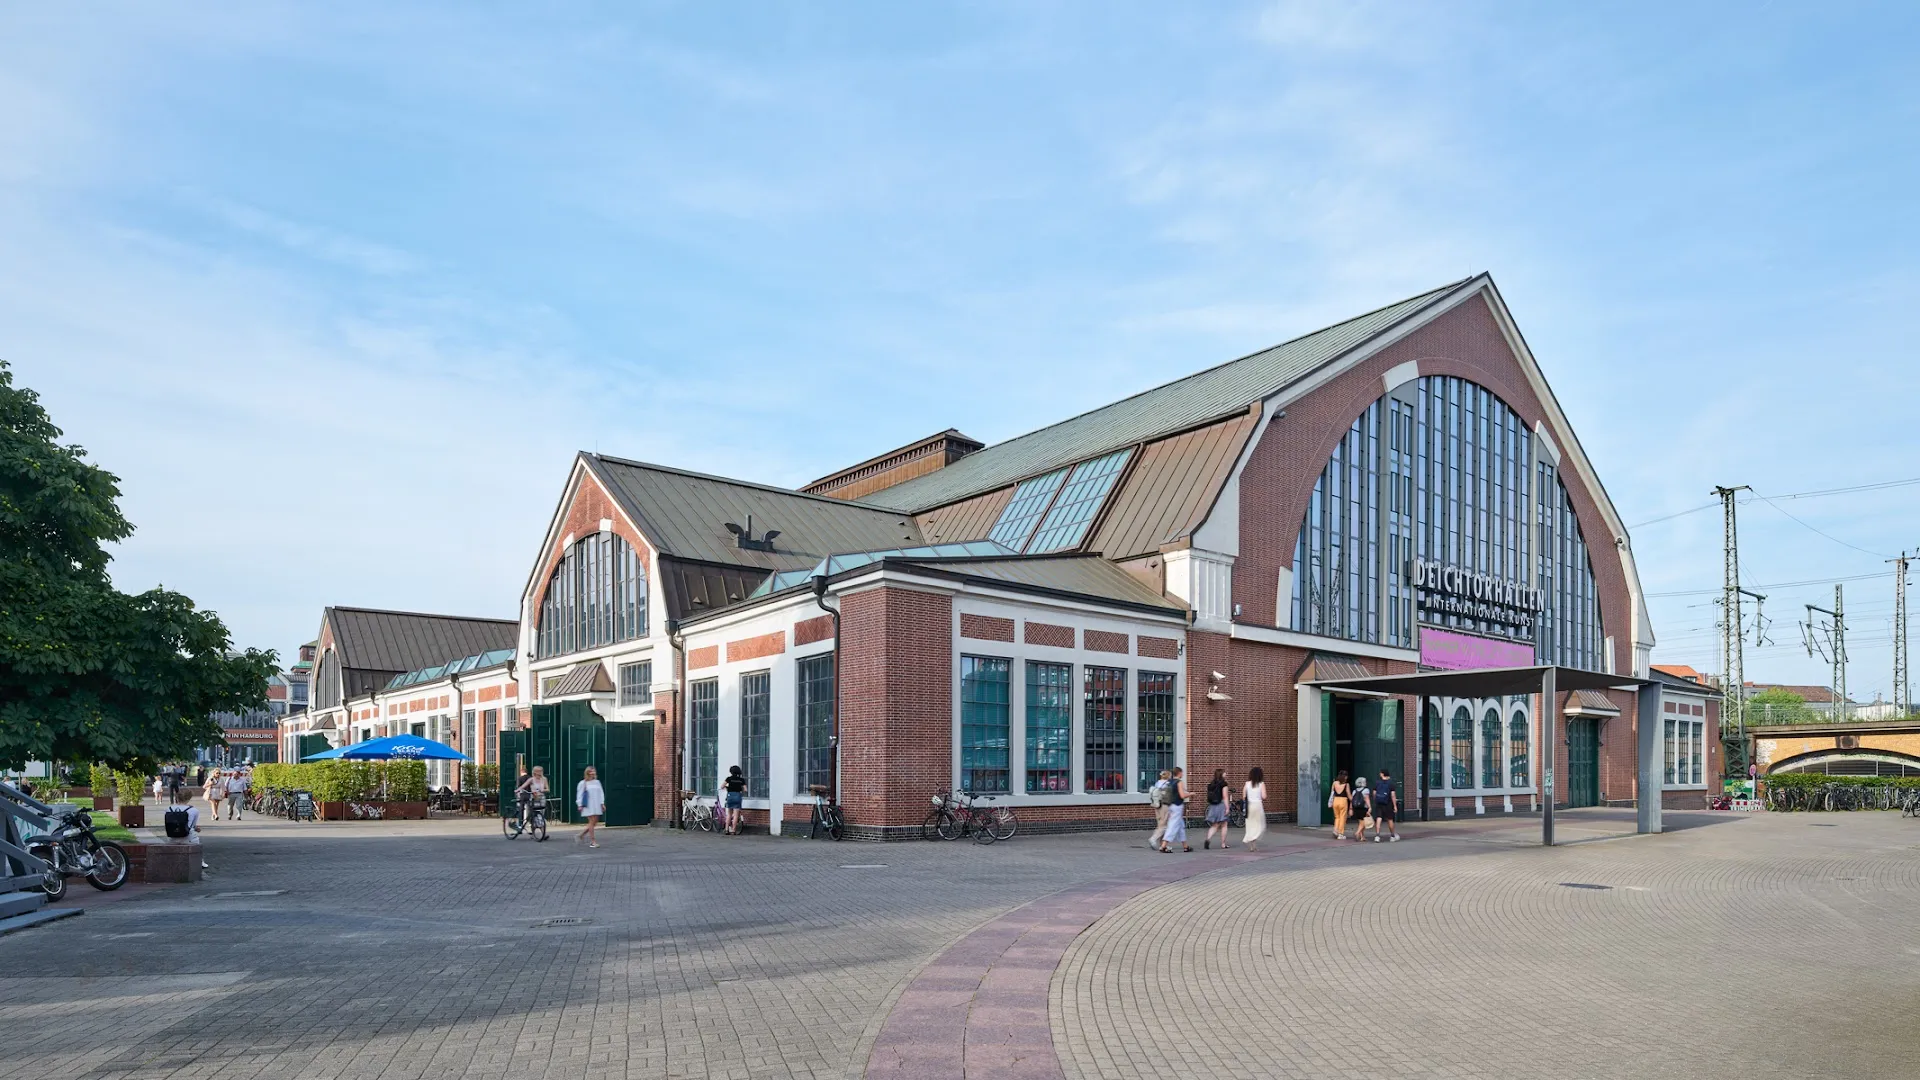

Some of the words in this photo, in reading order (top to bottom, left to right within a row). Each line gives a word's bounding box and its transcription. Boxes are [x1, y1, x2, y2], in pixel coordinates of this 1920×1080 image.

[1413, 559, 1545, 611] DEICHTORHALLEN
[1426, 597, 1505, 622] INTERNATIONALE
[1509, 613, 1534, 628] KUNST
[964, 779, 1005, 789] BOOK
